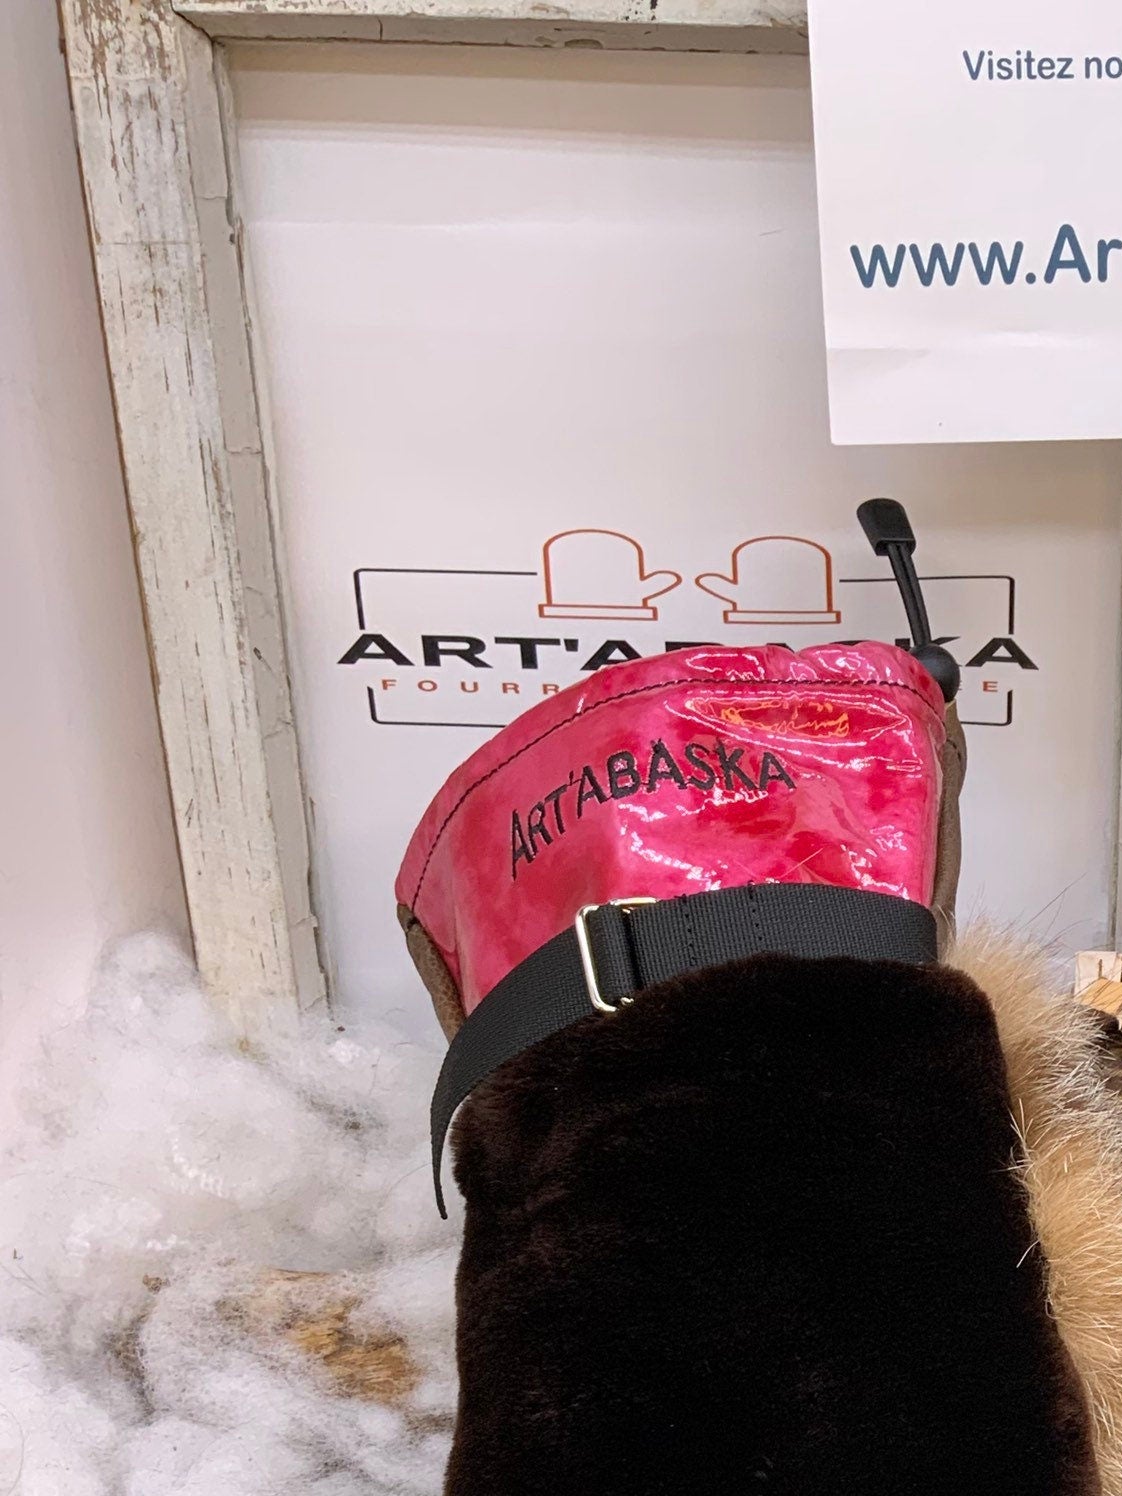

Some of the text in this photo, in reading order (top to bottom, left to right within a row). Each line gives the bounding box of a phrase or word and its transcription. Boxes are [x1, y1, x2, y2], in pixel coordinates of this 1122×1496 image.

[961, 49, 1076, 81] Visitez
[336, 633, 1040, 671] ART'AA
[381, 678, 561, 695] FOURR
[509, 737, 797, 881] ART'ABASKA
